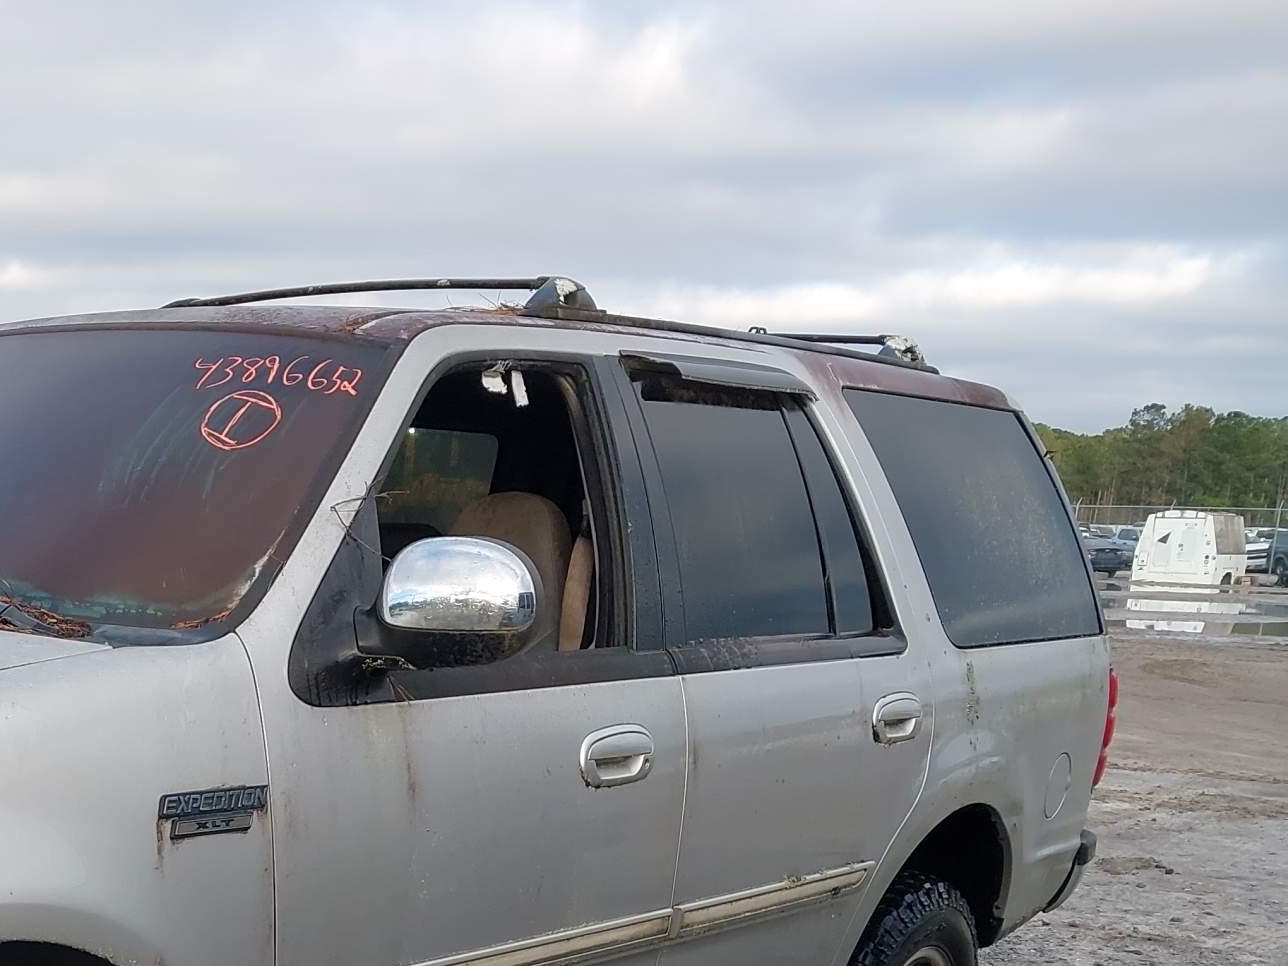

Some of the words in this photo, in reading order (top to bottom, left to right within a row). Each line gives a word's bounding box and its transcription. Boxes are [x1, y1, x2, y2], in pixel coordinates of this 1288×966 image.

[195, 356, 362, 395] 43896652
[163, 788, 267, 814] EXPEDITION
[196, 819, 234, 830] XLT
